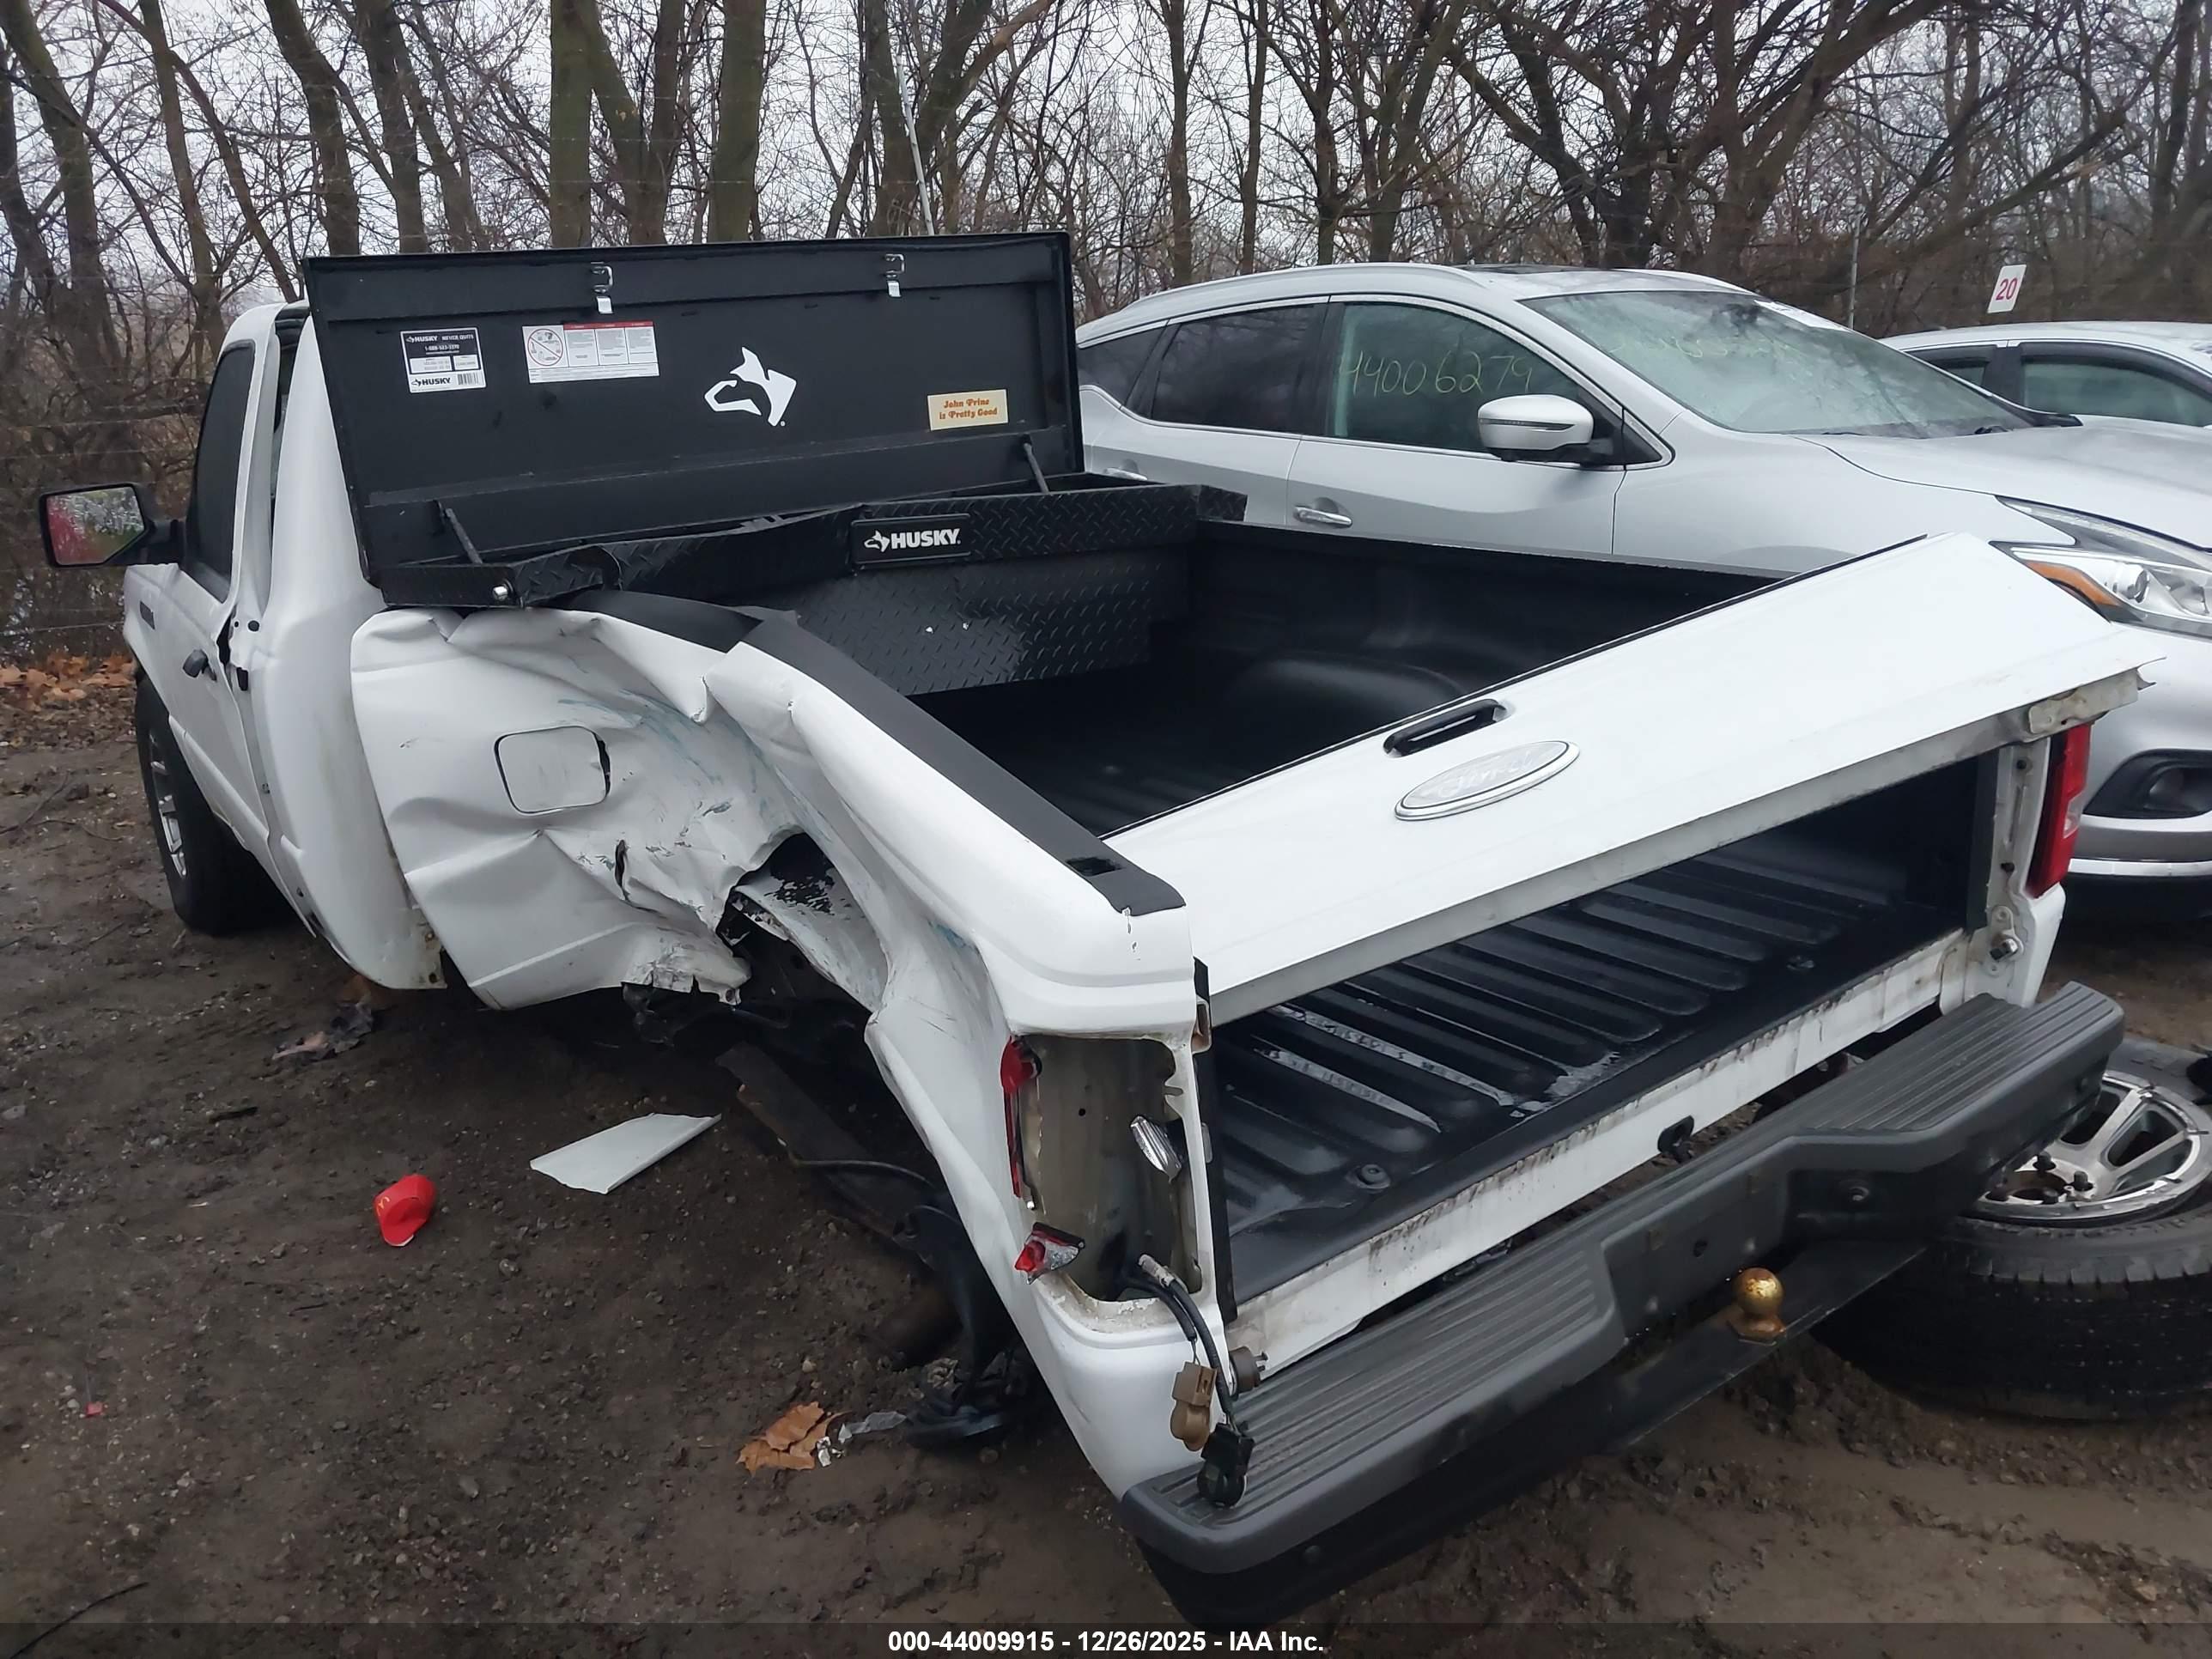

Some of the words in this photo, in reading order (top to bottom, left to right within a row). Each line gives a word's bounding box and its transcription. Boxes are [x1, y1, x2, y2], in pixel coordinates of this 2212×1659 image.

[1996, 277, 2018, 301] 20
[1338, 349, 1533, 397] 44006279
[422, 377, 451, 386] HUSKY
[944, 400, 963, 409] John
[965, 398, 989, 406] Prine
[948, 410, 975, 418] Pretty
[977, 407, 998, 416] Good
[890, 528, 960, 550] HUSKY
